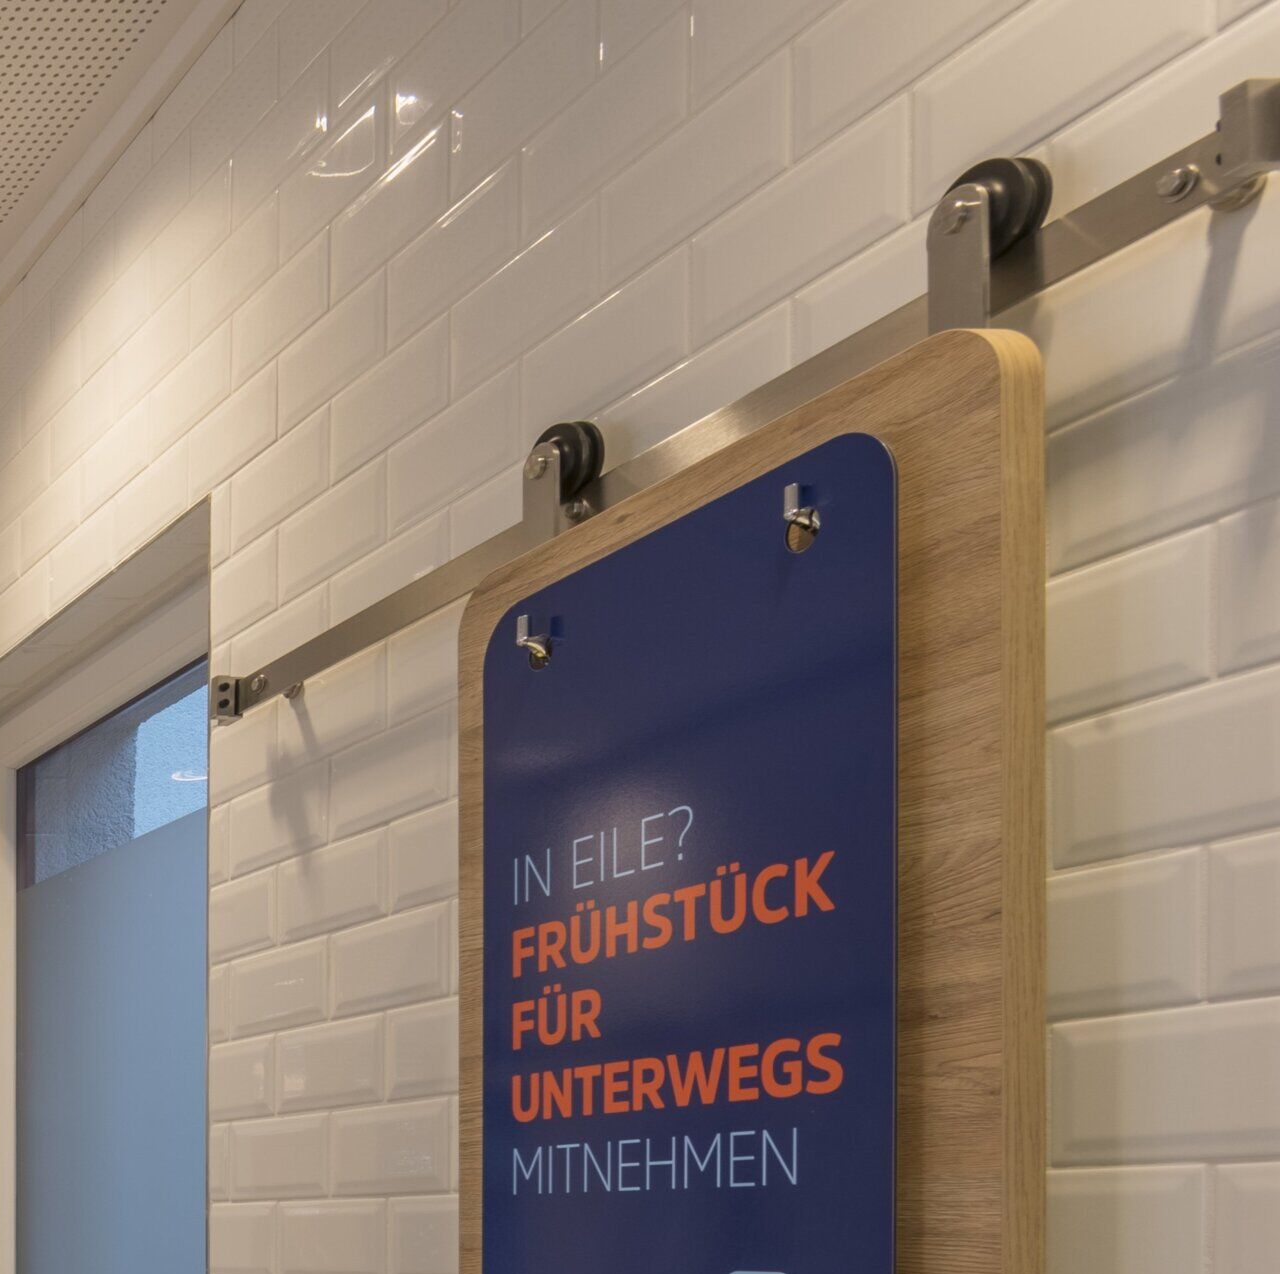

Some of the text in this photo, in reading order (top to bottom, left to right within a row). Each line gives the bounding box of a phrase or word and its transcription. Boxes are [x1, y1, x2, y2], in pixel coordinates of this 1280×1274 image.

[513, 805, 694, 906] IN EILE?
[511, 850, 837, 979] FRÜHSTÜCK
[511, 982, 603, 1051] FÜR
[511, 1032, 845, 1124] UNTERWEGS
[512, 1127, 798, 1196] MITNEHMEN
